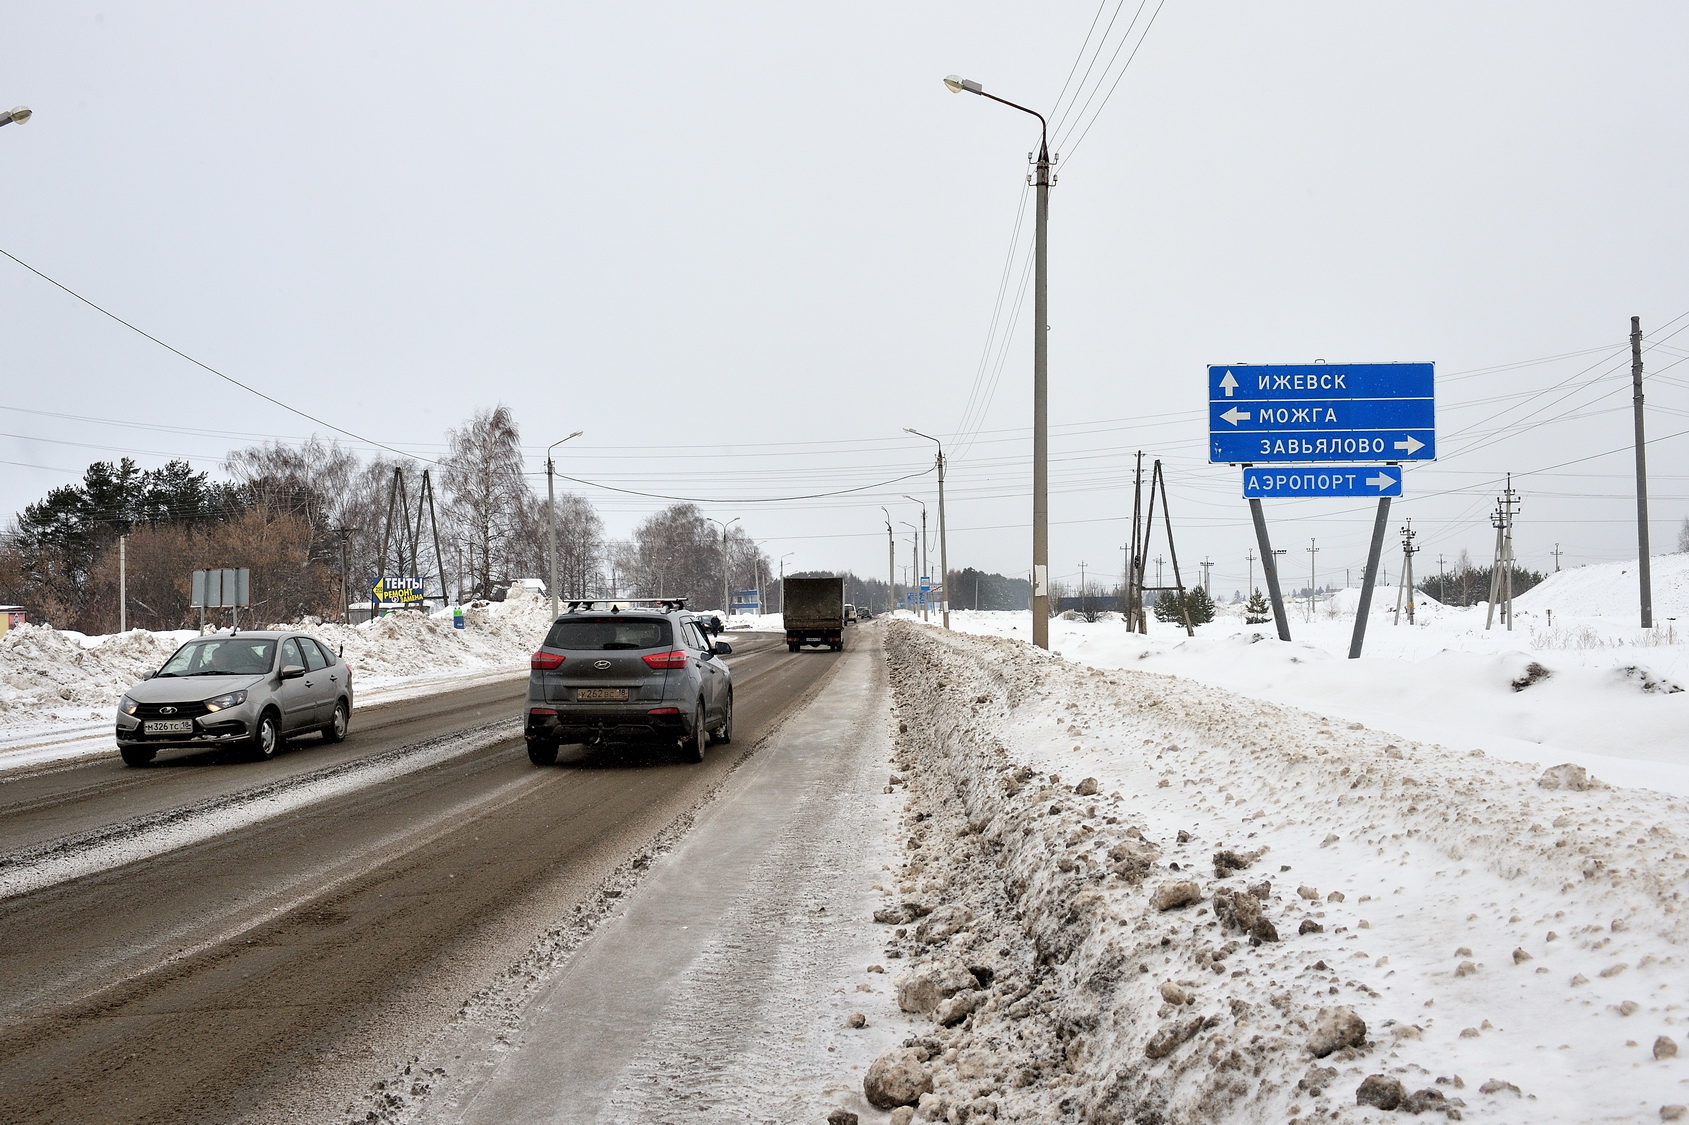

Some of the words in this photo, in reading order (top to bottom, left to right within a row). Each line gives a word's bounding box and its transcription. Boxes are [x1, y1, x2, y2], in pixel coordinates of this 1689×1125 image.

[1257, 374, 1347, 390] ИЖЕВСК
[1259, 407, 1338, 424] МОЖГА
[1259, 438, 1385, 455] ЗАВЬЯЛОВО
[1247, 474, 1357, 491] АЭРОПОРТ
[384, 577, 423, 589] ТЕНТЫ
[383, 588, 413, 599] РЕМОНТ
[400, 593, 424, 603] ЗАМЕНА
